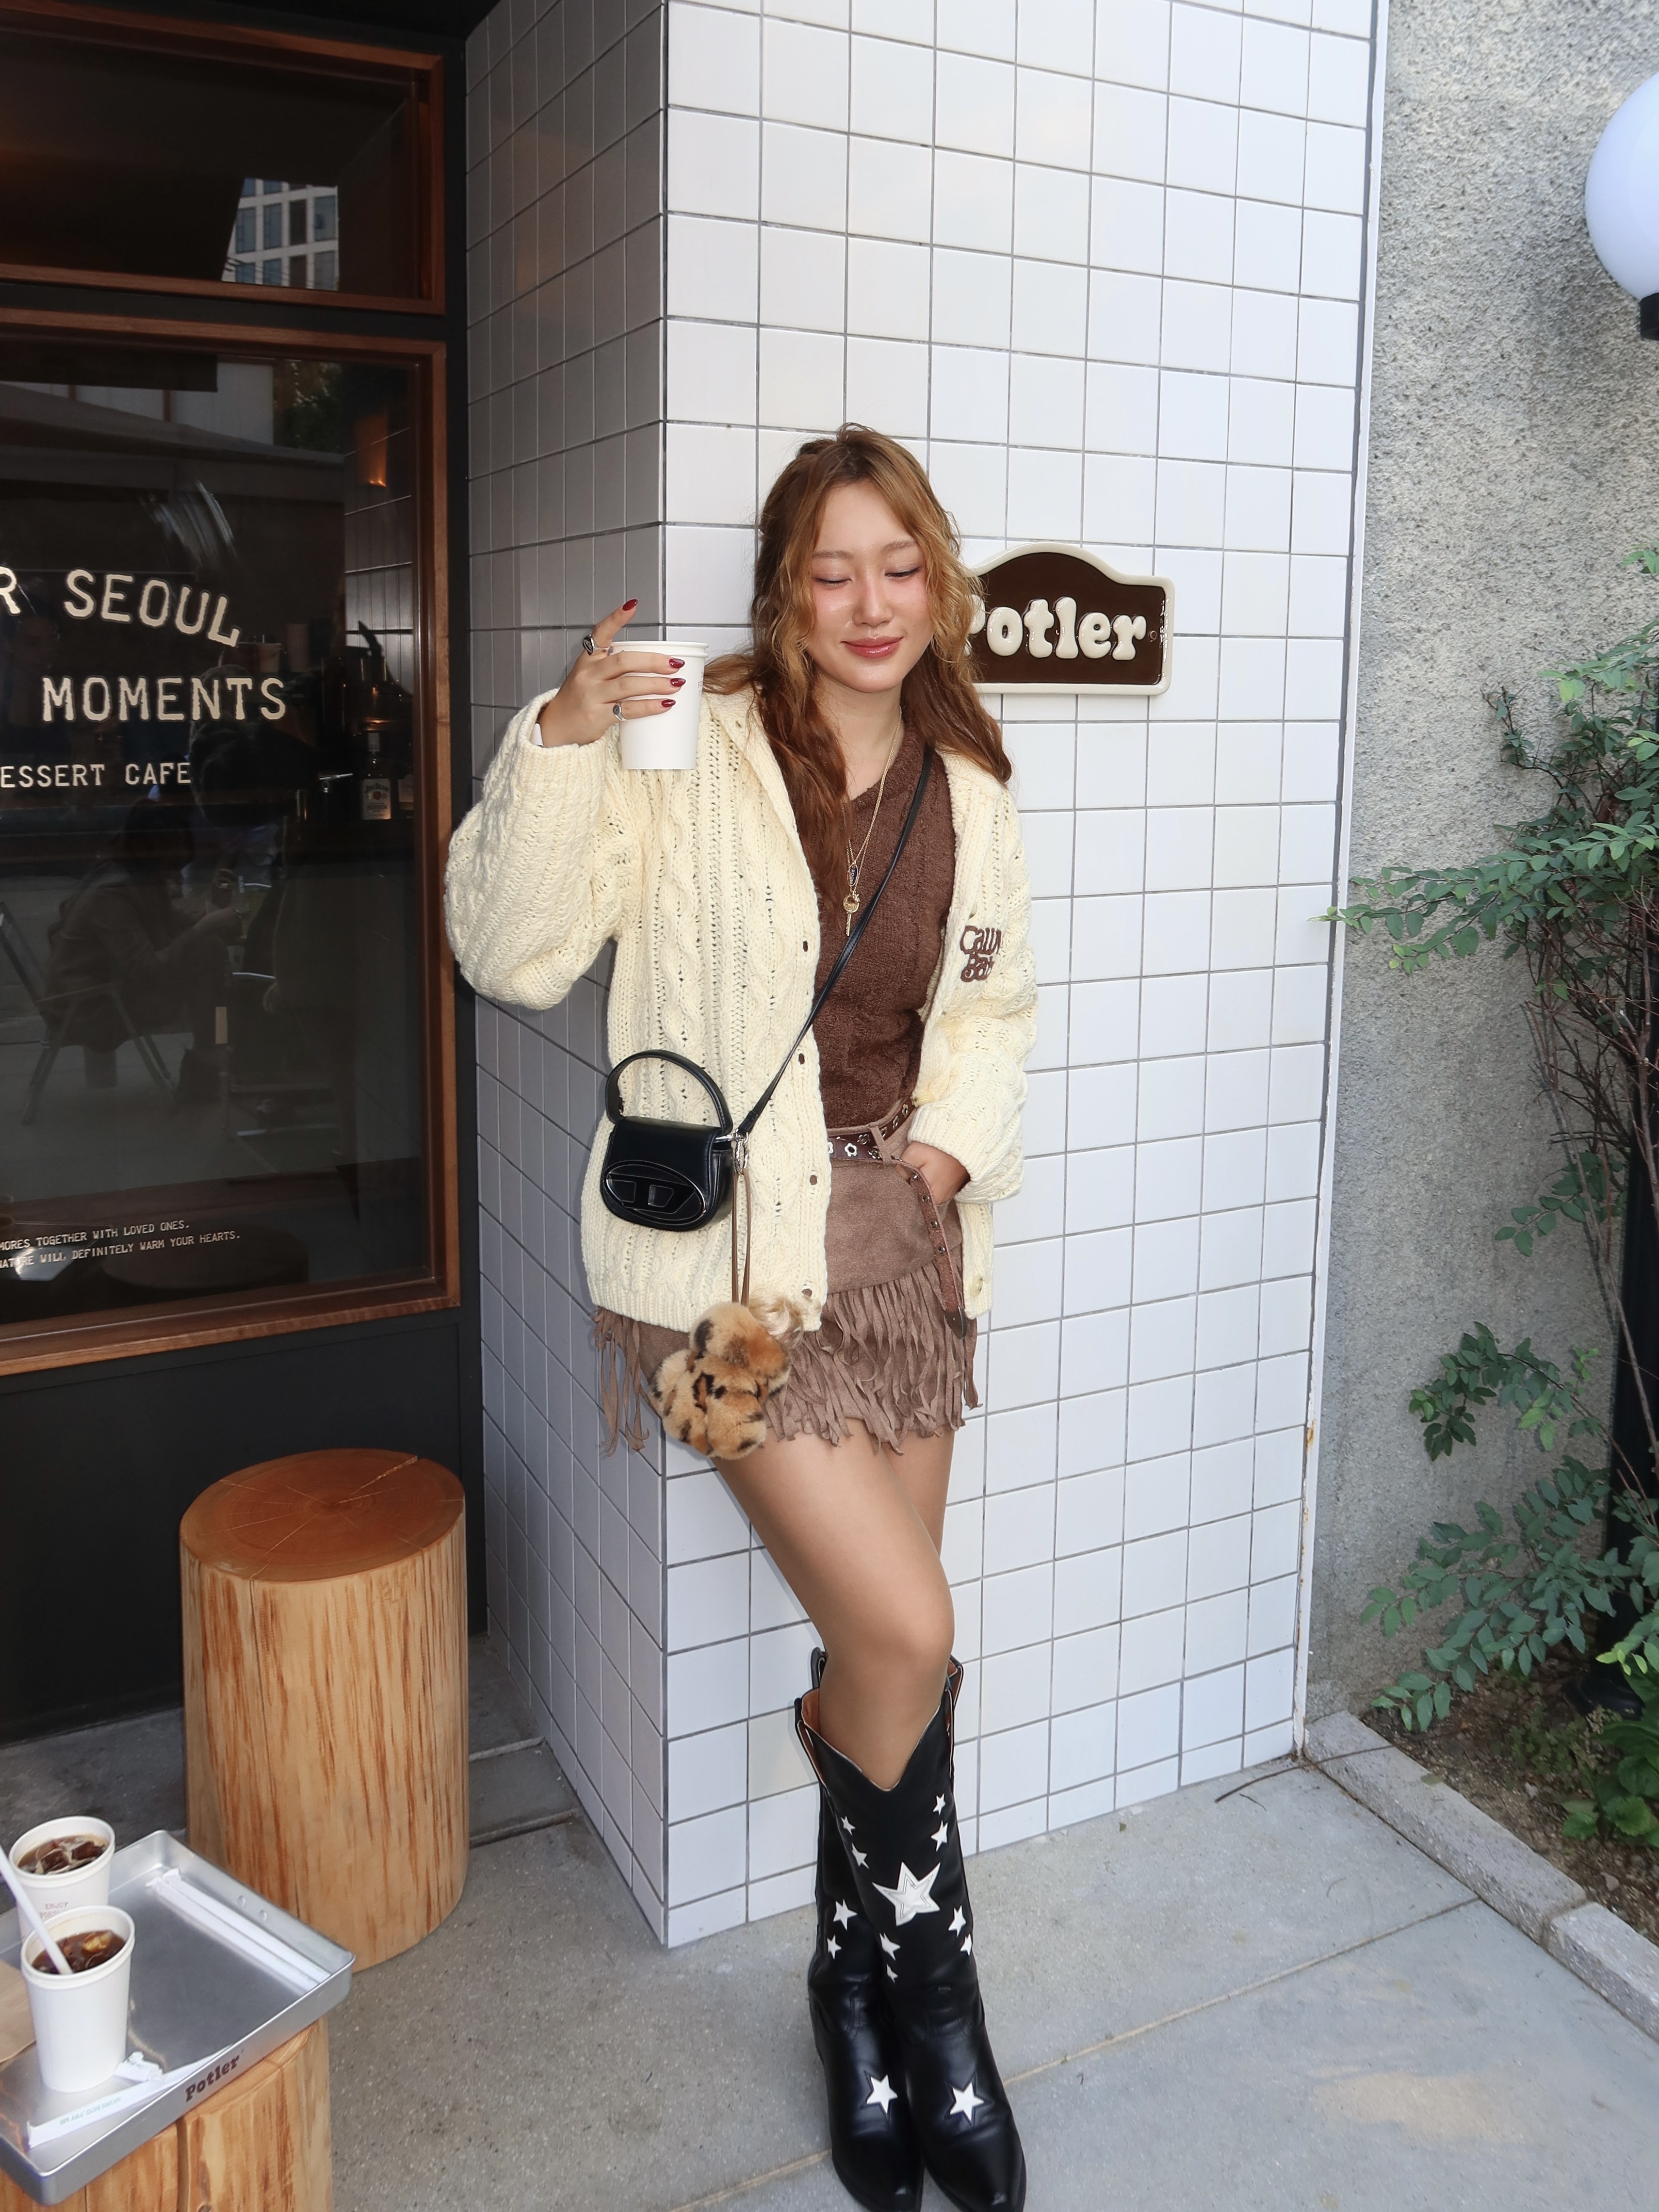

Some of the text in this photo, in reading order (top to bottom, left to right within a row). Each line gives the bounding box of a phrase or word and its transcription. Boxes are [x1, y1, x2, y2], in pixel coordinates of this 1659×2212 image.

[65, 569, 240, 648] SEOUL
[43, 677, 286, 721] MOMENTS
[0, 762, 191, 788] ESSERT CAFE
[36, 1232, 87, 1247] TOGETHER
[93, 1228, 118, 1240] WITH
[123, 1224, 155, 1236] LOVED
[160, 1220, 190, 1231] ONES.
[40, 1252, 66, 1264] WILL
[72, 1243, 134, 1260] DEFINITELY
[140, 1239, 165, 1251] WARM
[170, 1236, 195, 1247] YOUR
[199, 1231, 241, 1243] HEARTS.
[185, 2055, 240, 2103] Potler
